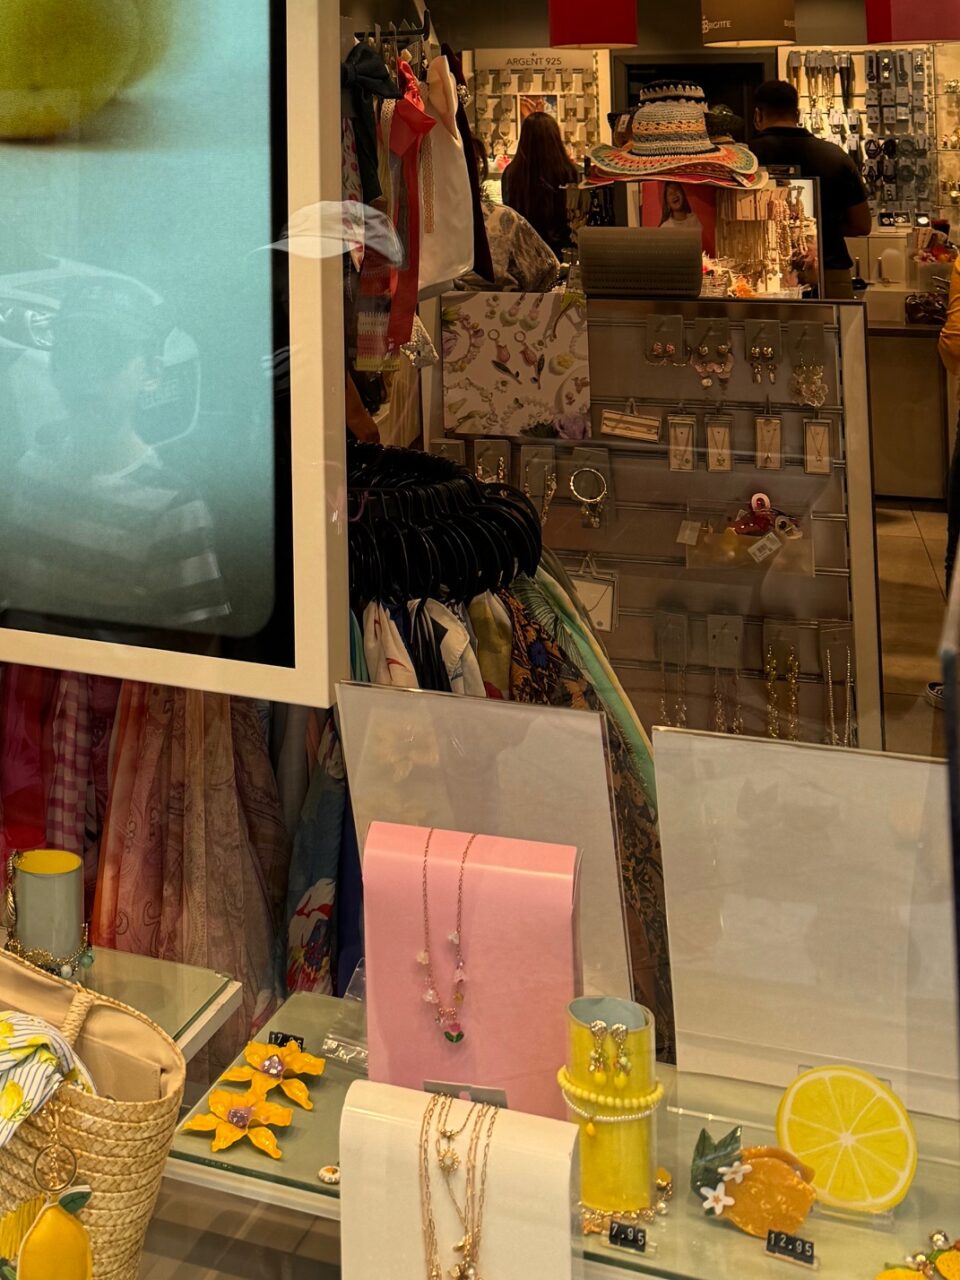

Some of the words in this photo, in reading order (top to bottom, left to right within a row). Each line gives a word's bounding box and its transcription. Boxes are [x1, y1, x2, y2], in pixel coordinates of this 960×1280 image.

[506, 57, 544, 66] ARGENT
[545, 57, 562, 66] 925
[611, 1223, 645, 1246] 7.95
[769, 1233, 813, 1257] 12.95
